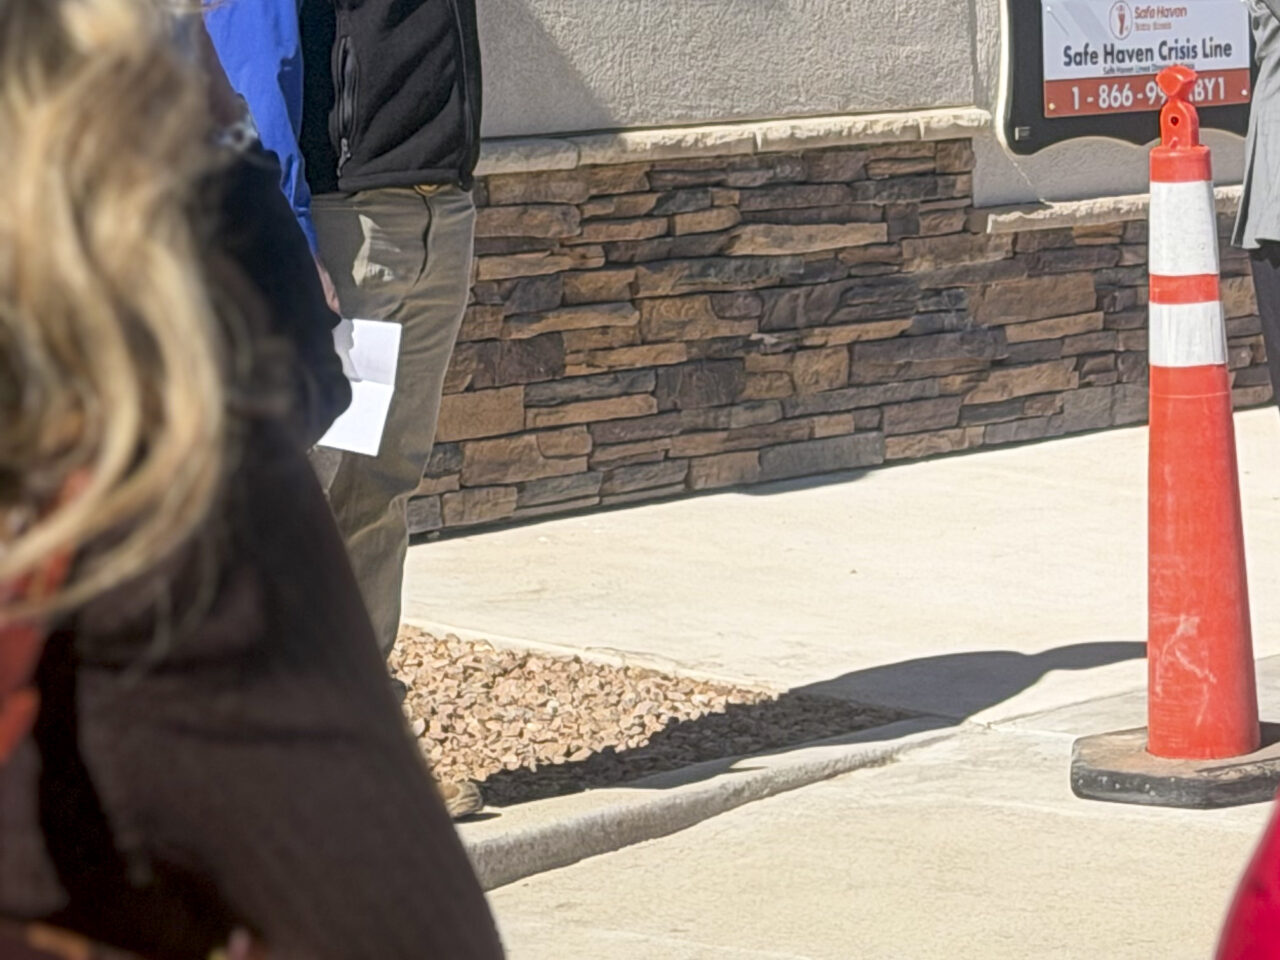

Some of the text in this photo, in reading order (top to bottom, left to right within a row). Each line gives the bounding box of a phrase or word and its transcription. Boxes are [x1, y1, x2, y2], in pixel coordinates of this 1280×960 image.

[1134, 5, 1187, 20] Safe Haven
[1063, 36, 1232, 67] Safe Haven Crisis Line
[1071, 85, 1079, 110] 1
[1098, 82, 1133, 109] 866
